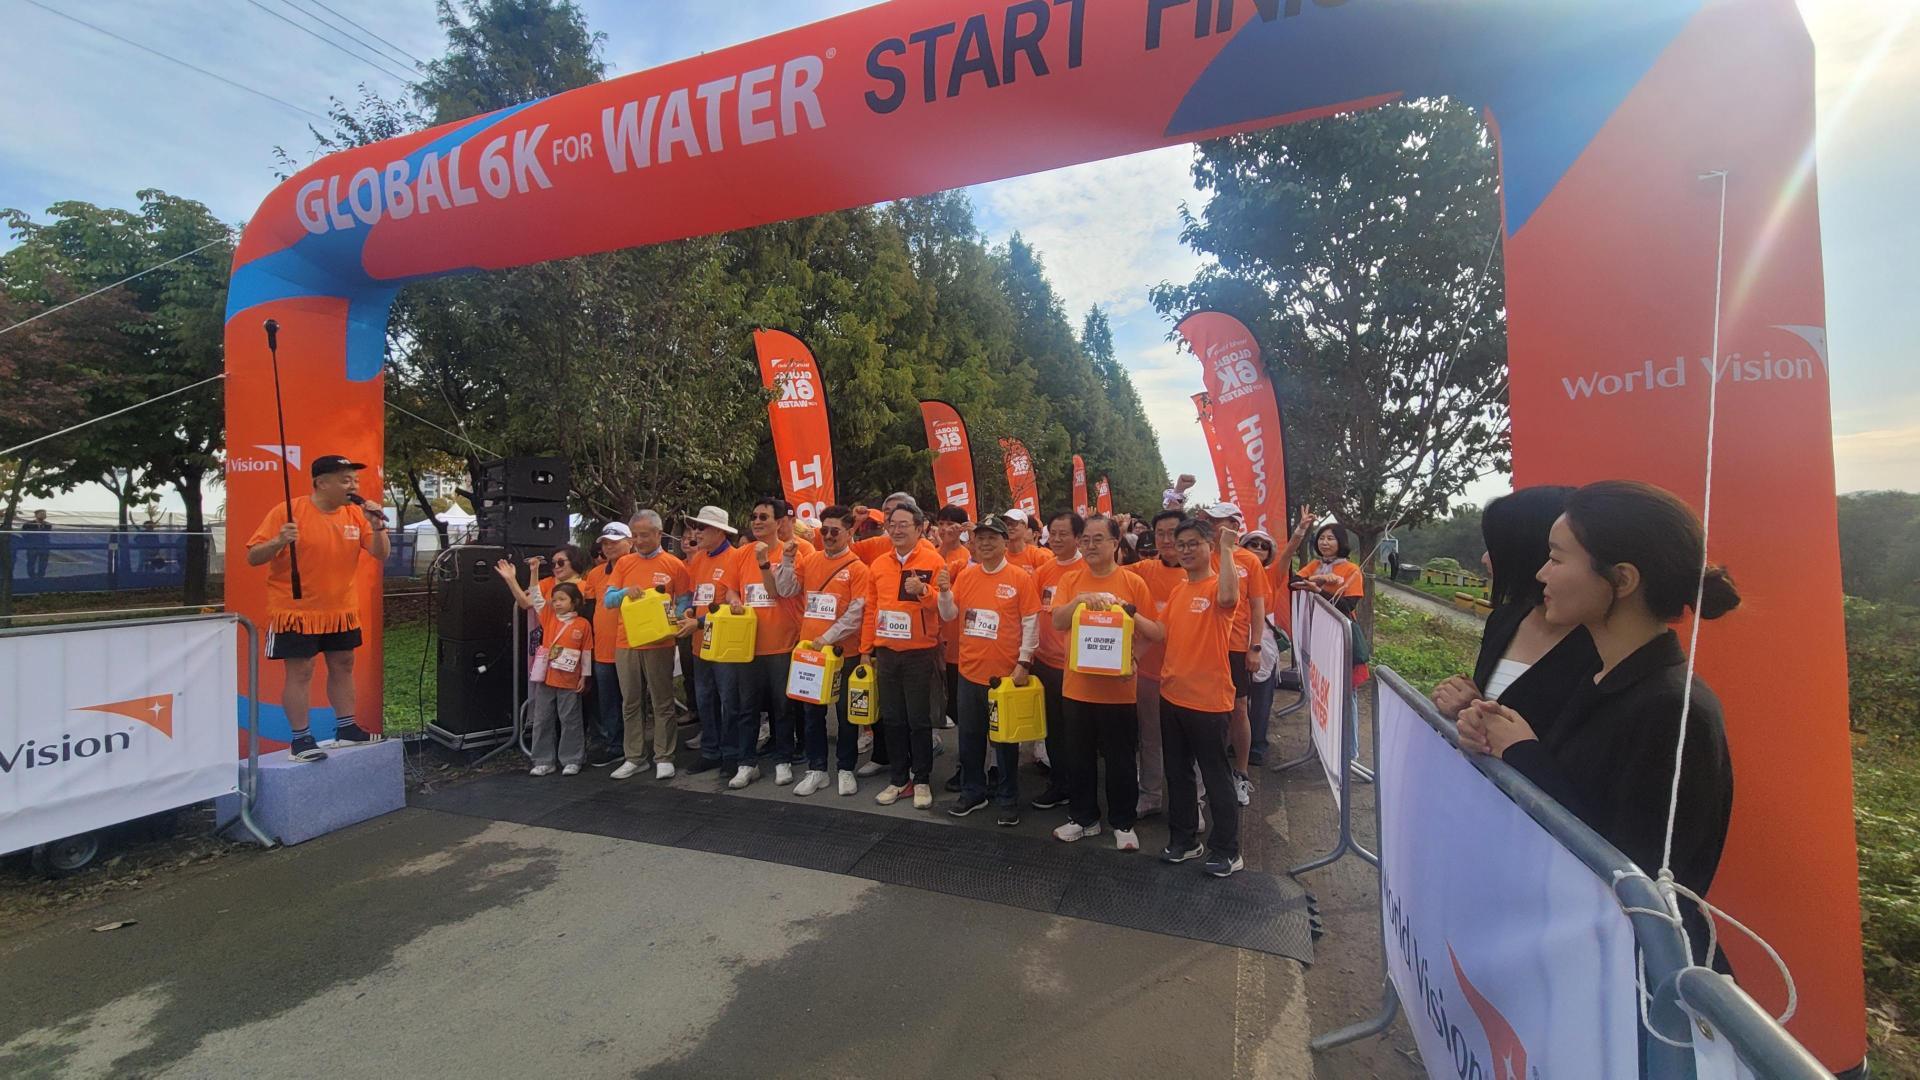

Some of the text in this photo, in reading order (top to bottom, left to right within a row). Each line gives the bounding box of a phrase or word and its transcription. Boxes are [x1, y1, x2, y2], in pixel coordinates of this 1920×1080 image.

[864, 0, 1085, 114] START
[296, 55, 826, 234] GLOBAL 6K FOR WATER
[1561, 351, 1813, 400] World Vision
[231, 457, 279, 472] Vision
[0, 731, 130, 774] Vision
